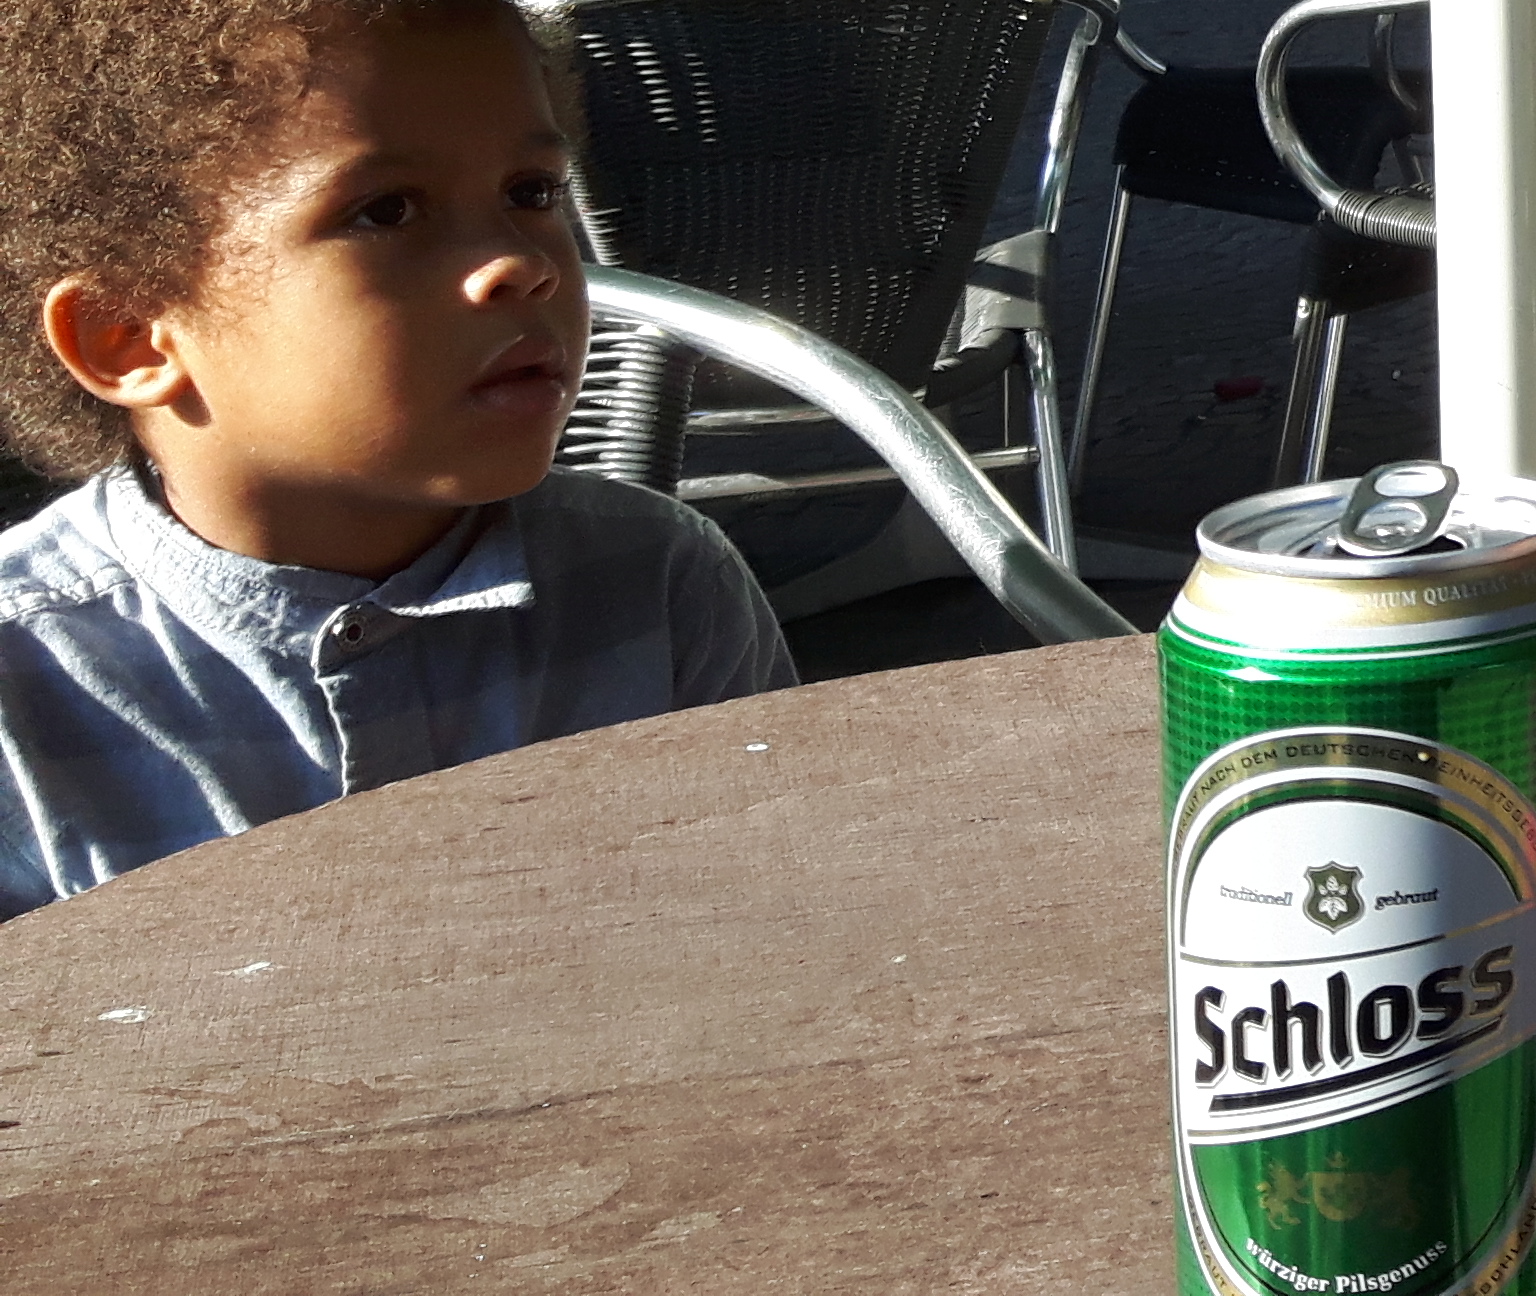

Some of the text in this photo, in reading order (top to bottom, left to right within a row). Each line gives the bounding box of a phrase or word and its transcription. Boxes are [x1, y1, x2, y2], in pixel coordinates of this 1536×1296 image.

[1201, 764, 1237, 795] NACH
[1240, 749, 1278, 769] DEM
[1285, 743, 1415, 762] DEUTSCHEN
[1374, 887, 1439, 910] gebraut
[1195, 945, 1515, 1088] Schloss
[1246, 1237, 1448, 1294] würziger Pilsgenuss
